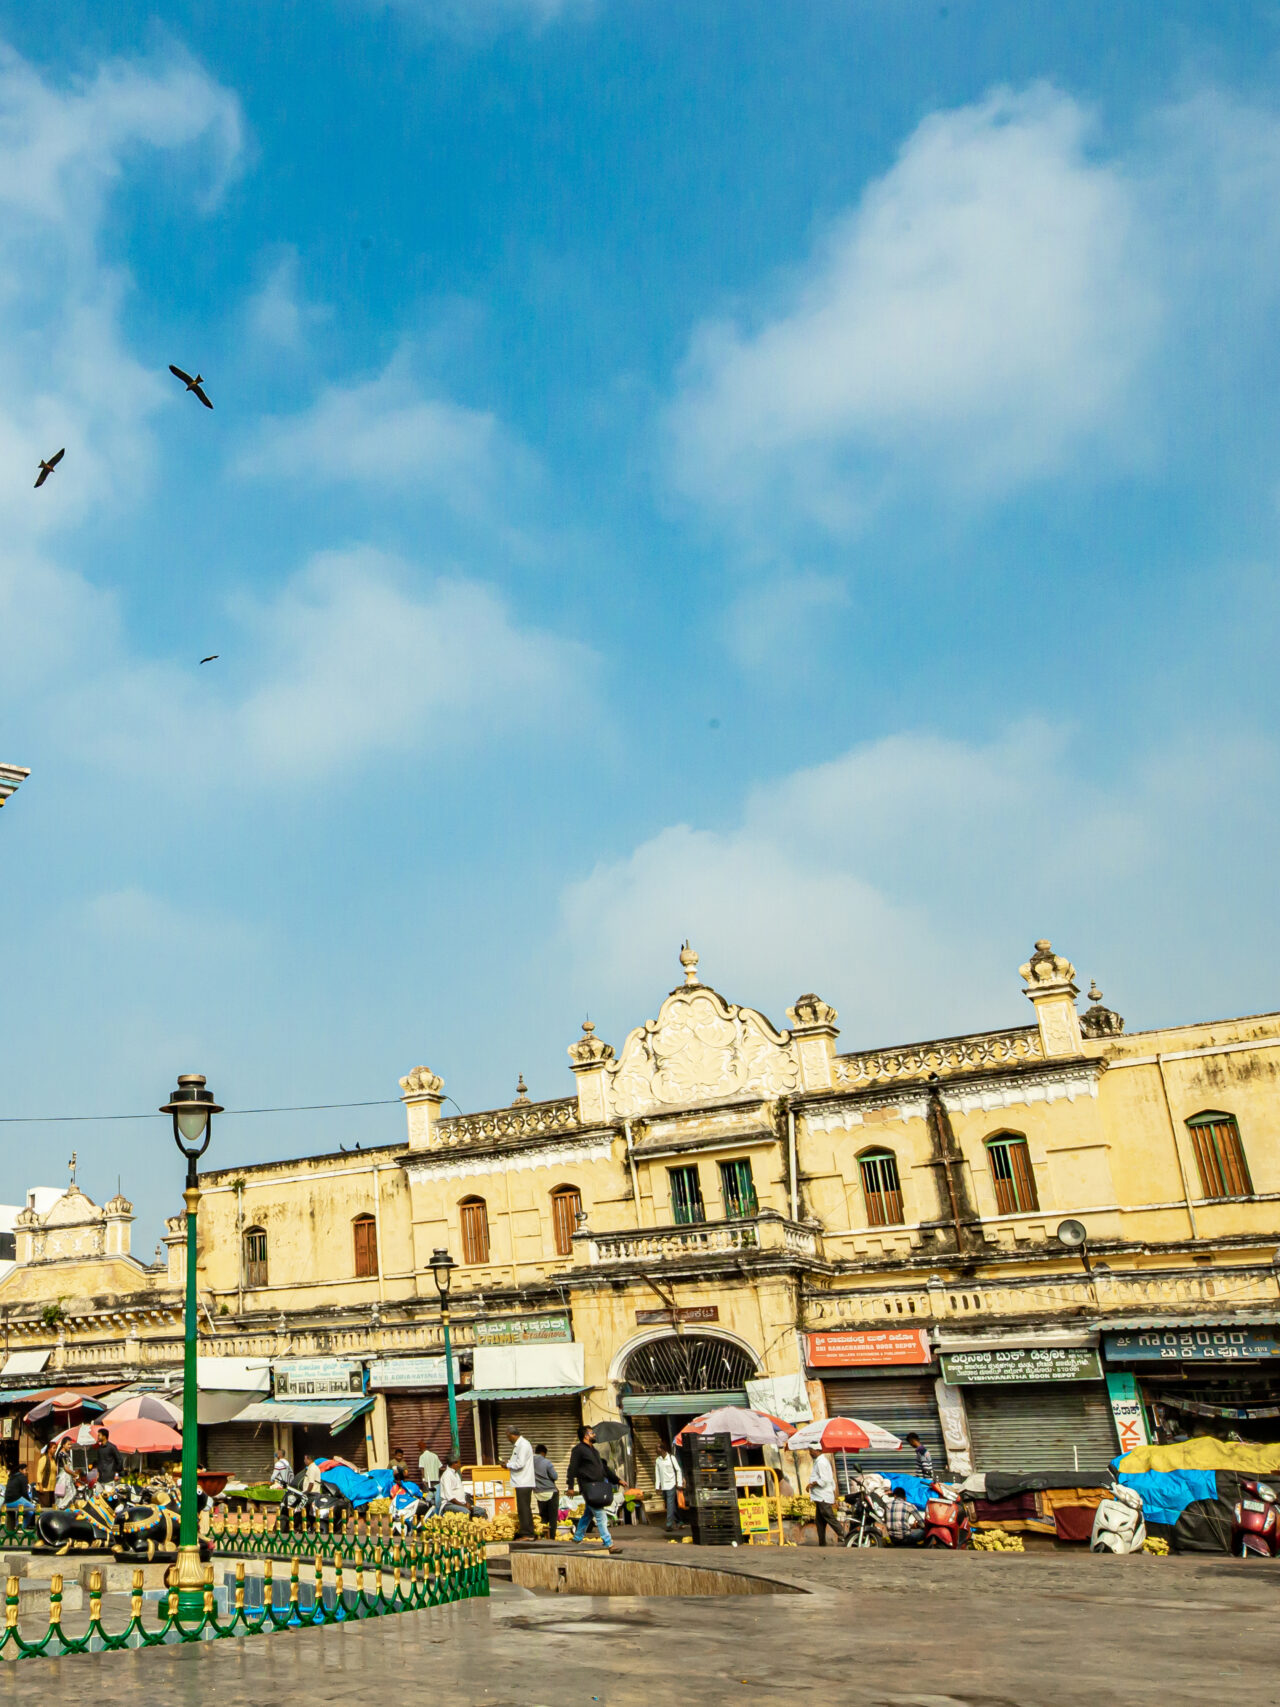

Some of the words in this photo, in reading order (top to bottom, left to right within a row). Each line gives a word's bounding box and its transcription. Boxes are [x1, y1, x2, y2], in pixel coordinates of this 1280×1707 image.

[477, 1332, 521, 1345] PRIME
[828, 1344, 875, 1352] RAMACHANDRA
[996, 1350, 1026, 1361] ಬುಕ್
